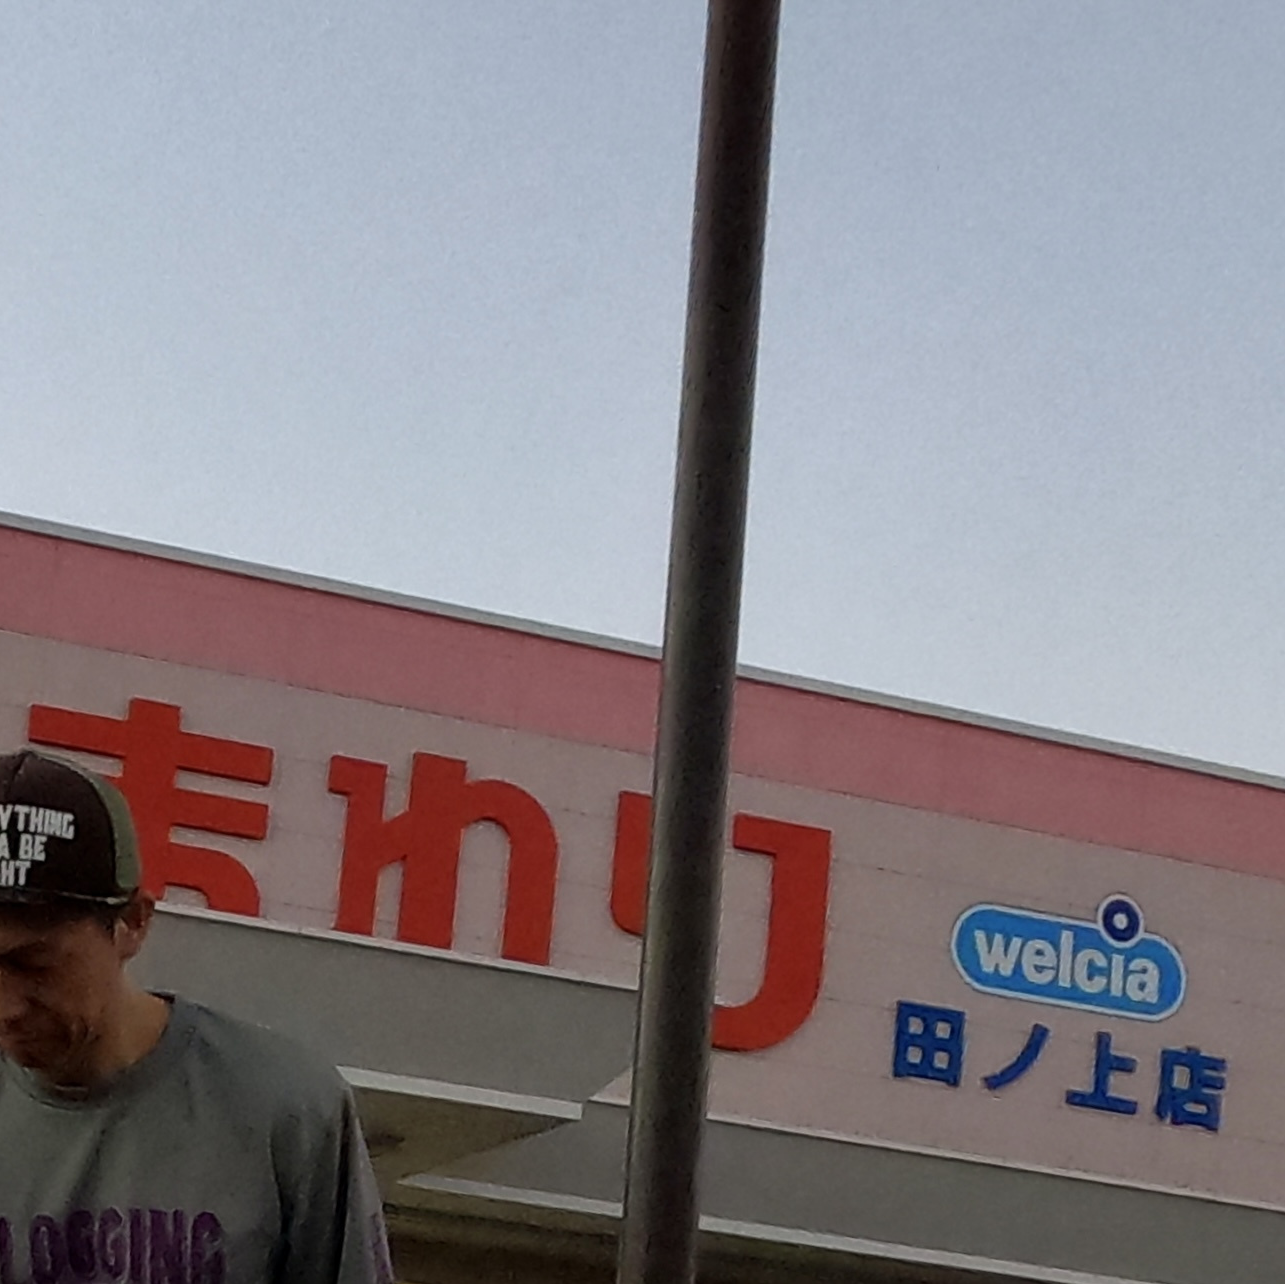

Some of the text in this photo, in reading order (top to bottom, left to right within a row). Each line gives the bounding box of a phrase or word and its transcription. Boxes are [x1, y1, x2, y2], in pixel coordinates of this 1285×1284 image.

[19, 833, 48, 861] BE
[974, 897, 1160, 1005] welcia
[892, 1000, 1227, 1134] 田ノ上店
